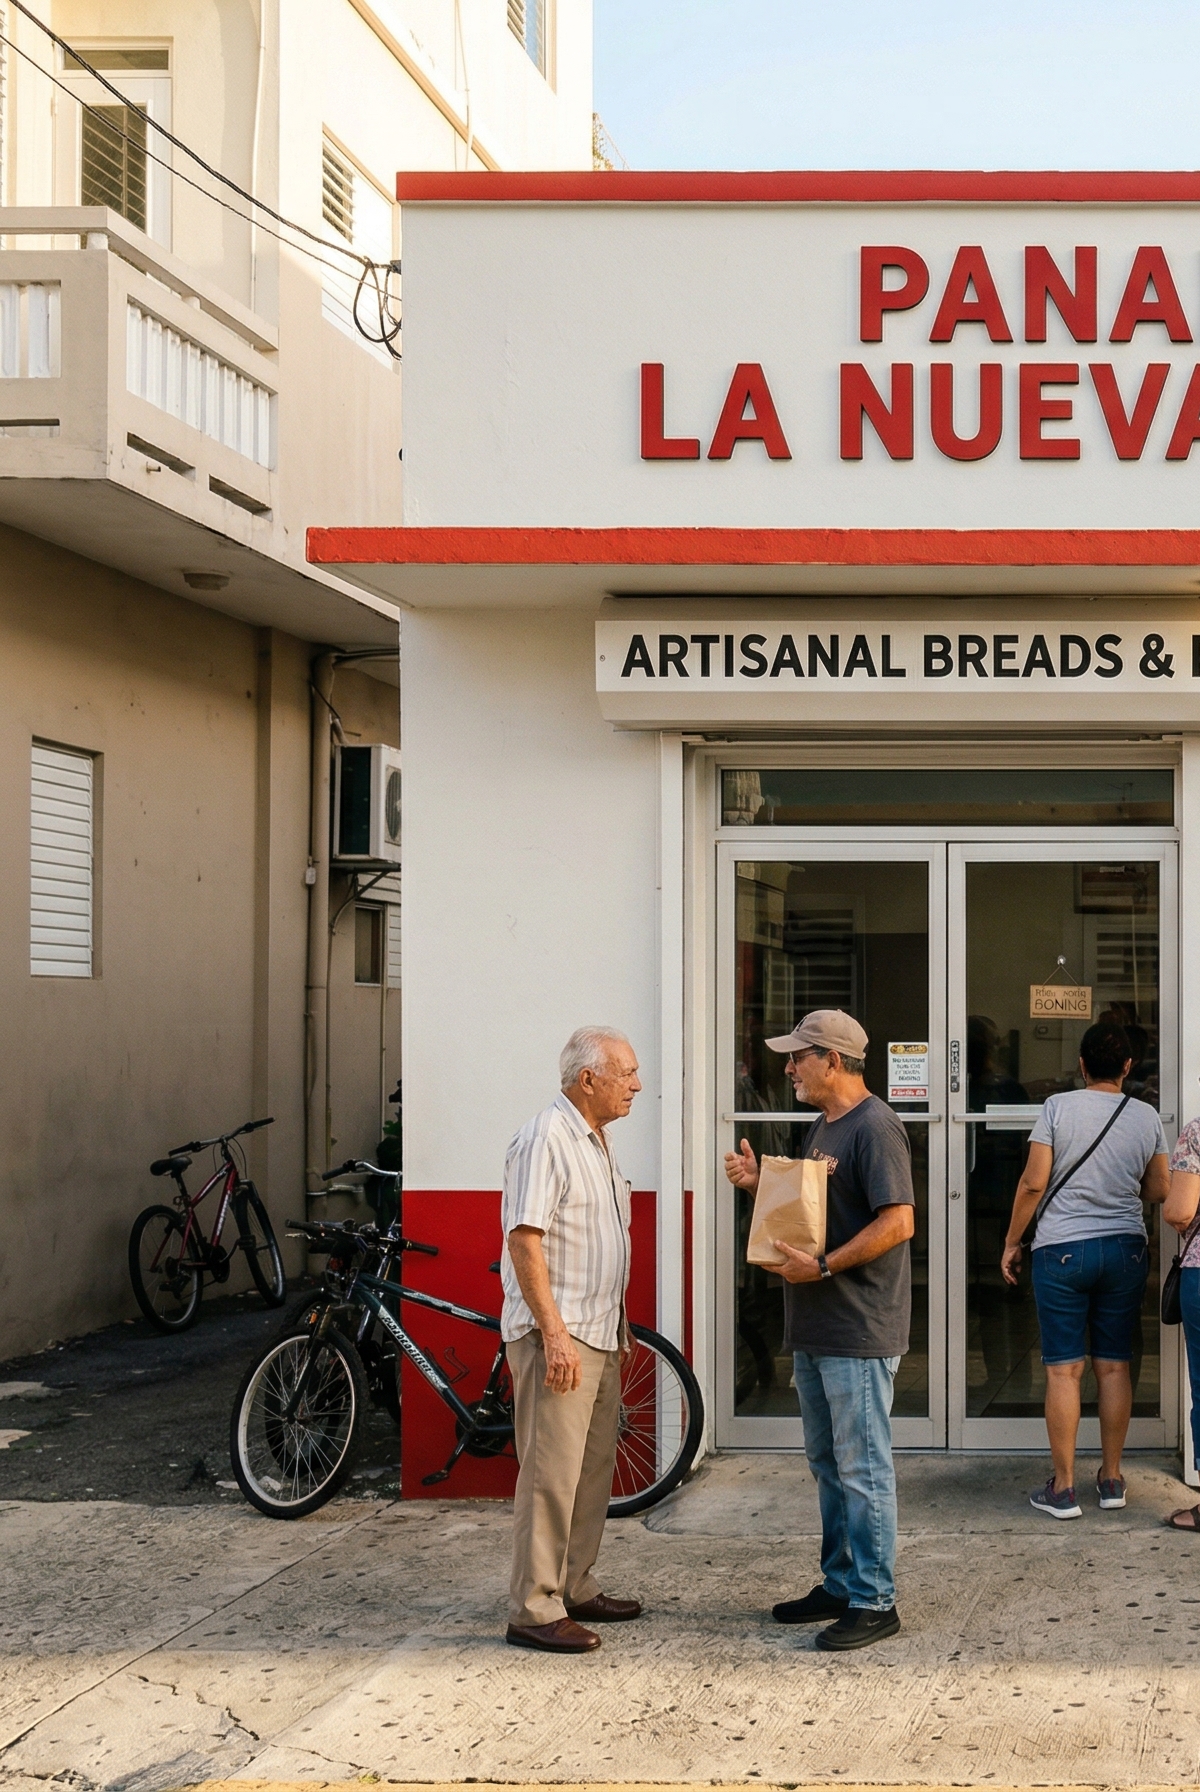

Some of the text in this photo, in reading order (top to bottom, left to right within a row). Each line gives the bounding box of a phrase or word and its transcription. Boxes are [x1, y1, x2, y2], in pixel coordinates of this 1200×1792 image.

[640, 362, 791, 461] LA
[620, 633, 907, 679] ARTISANAL
[923, 633, 1123, 679] BREADS
[1139, 633, 1175, 679] &
